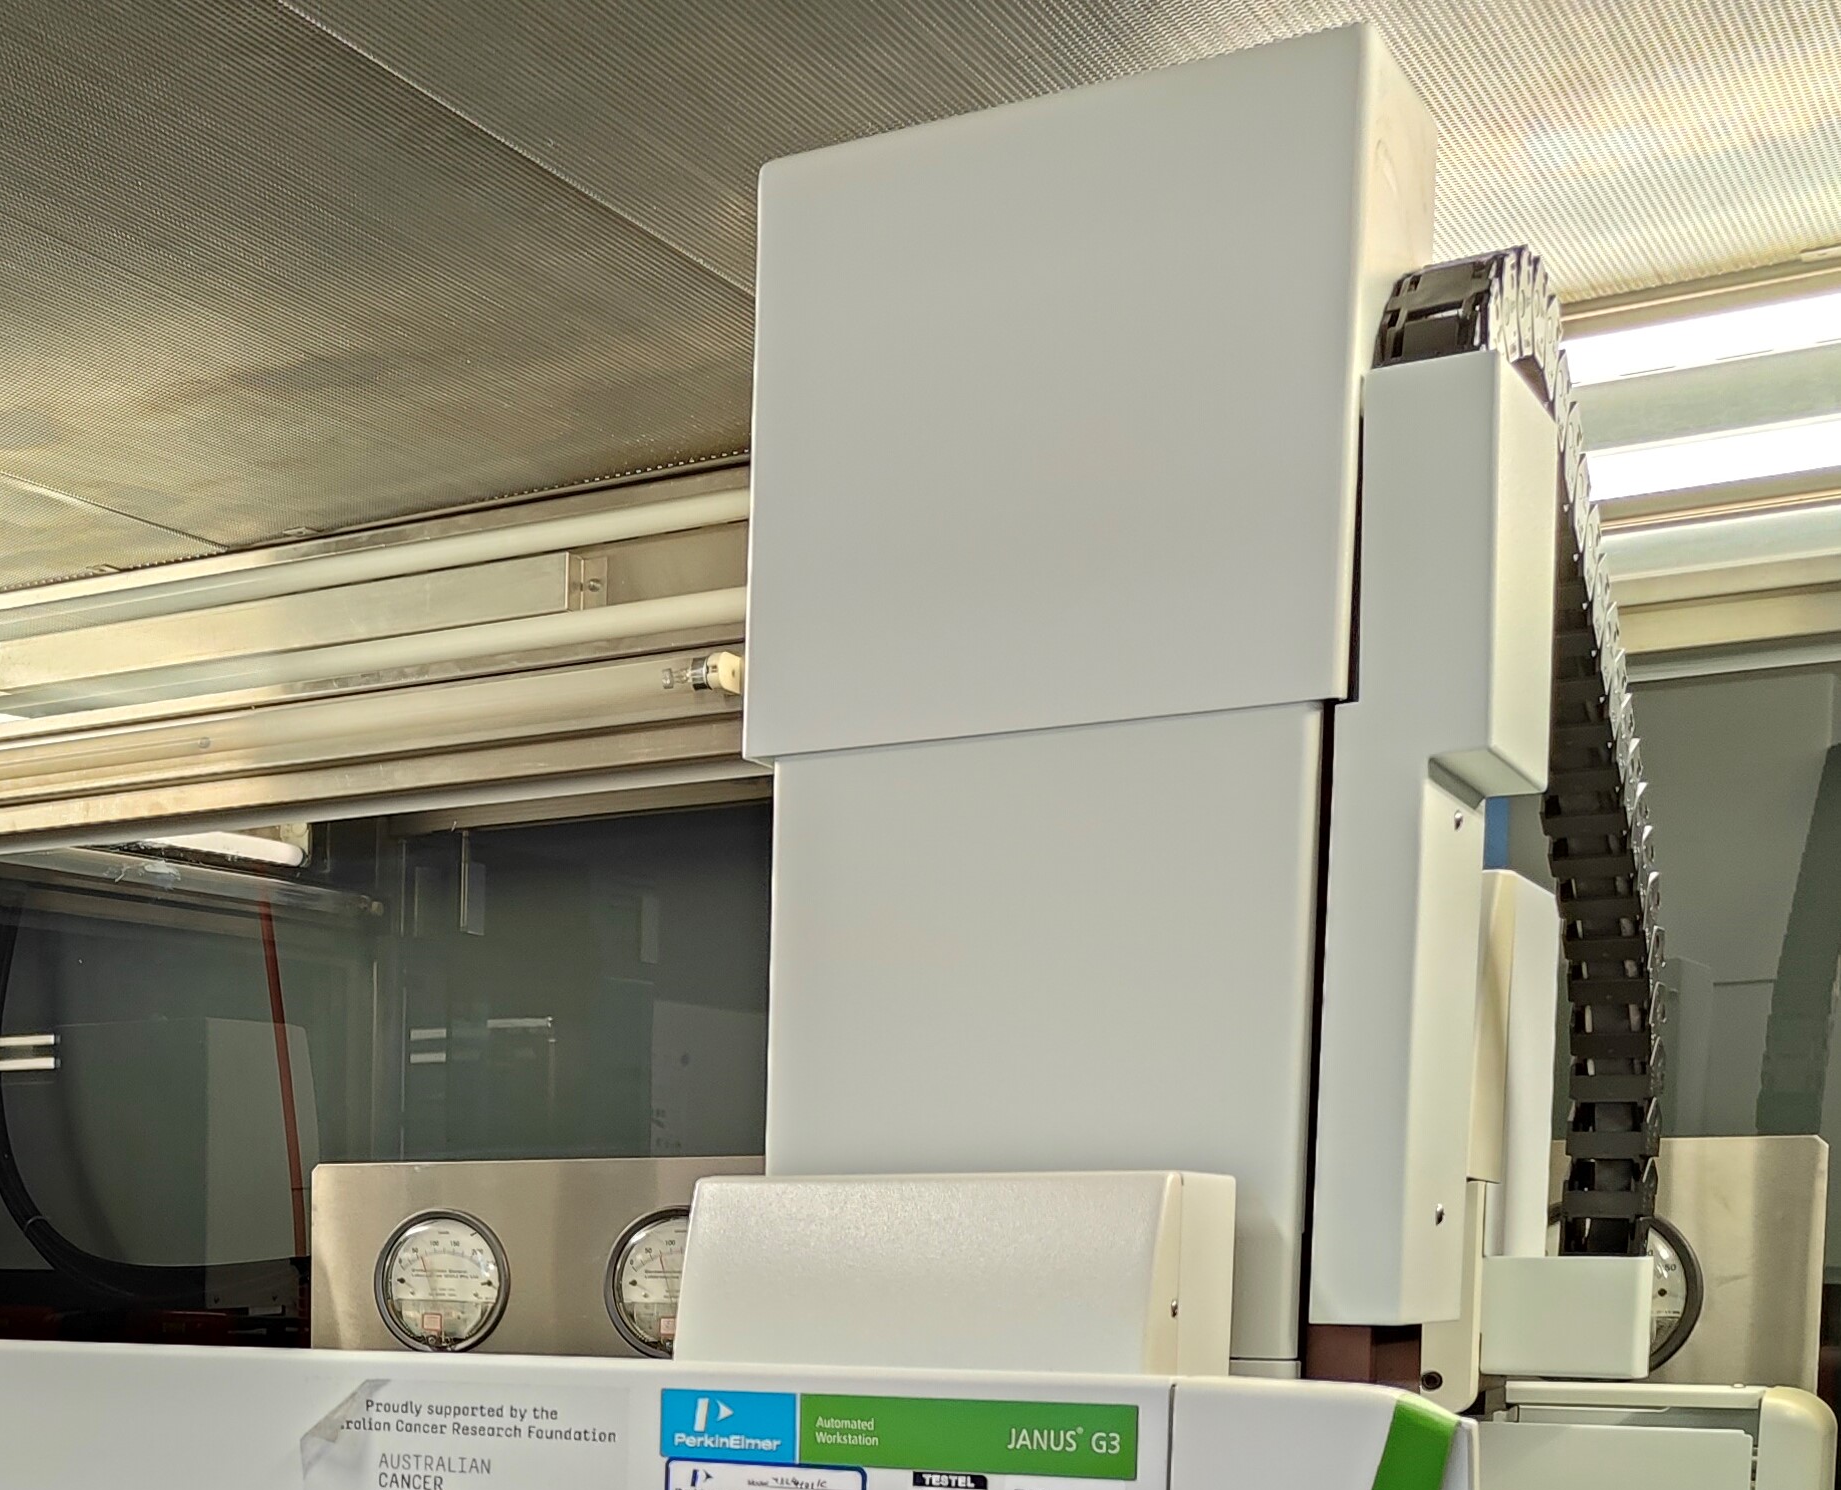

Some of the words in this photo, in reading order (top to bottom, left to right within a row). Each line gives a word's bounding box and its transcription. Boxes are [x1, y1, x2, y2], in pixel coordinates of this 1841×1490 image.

[365, 1400, 422, 1417] Proudly
[426, 1404, 505, 1420] supported
[510, 1406, 528, 1421] by
[532, 1406, 558, 1421] the
[340, 1417, 391, 1432] ralian
[395, 1420, 448, 1436] Cancer
[452, 1422, 522, 1439] Research
[527, 1425, 617, 1443] Foundation
[815, 1415, 875, 1431] Automated
[673, 1432, 782, 1452] PerkinElmer
[815, 1431, 880, 1447] Workstation
[1091, 1432, 1121, 1454] G3
[378, 1452, 493, 1475] AUSTRALIAN
[921, 1473, 975, 1488] TESTEL
